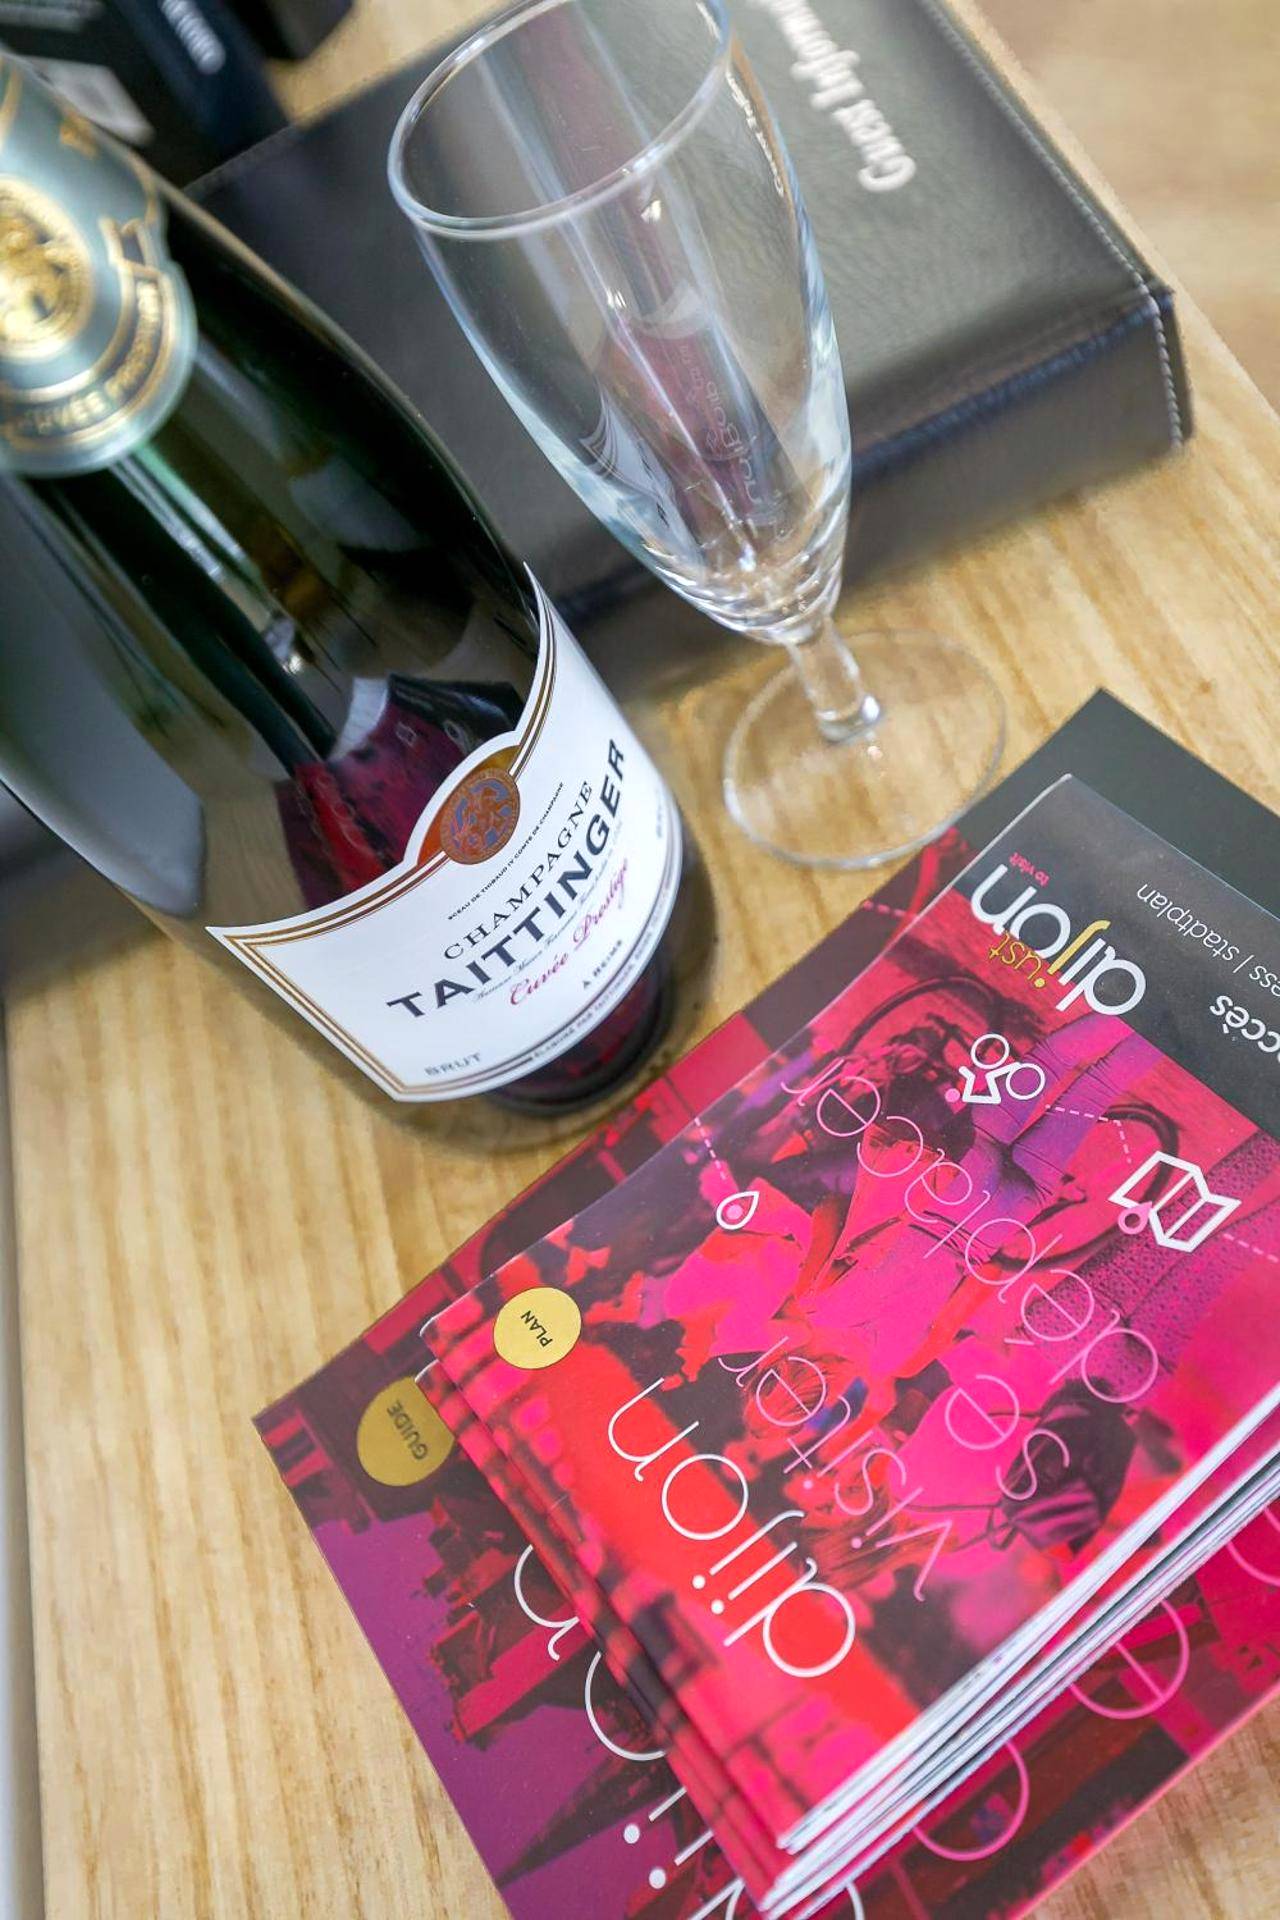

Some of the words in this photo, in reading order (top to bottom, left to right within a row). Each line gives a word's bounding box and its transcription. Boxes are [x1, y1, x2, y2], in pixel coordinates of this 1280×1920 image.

[832, 99, 917, 191] Guest
[387, 739, 625, 1017] TAITTINGER
[444, 780, 593, 960] CHAMPAGNE
[509, 952, 569, 1006] Cuvée
[572, 857, 629, 952] Prestige
[971, 863, 1146, 1015] dijon
[1136, 884, 1240, 961] stadtplan
[1209, 995, 1280, 1063] ccès
[781, 1058, 1158, 1403] déplacer
[520, 1309, 554, 1348] PLAN
[386, 1399, 429, 1461] GUIDE
[718, 1336, 953, 1601] visiter
[945, 1375, 1070, 1500] se
[608, 1378, 856, 1677] dijon
